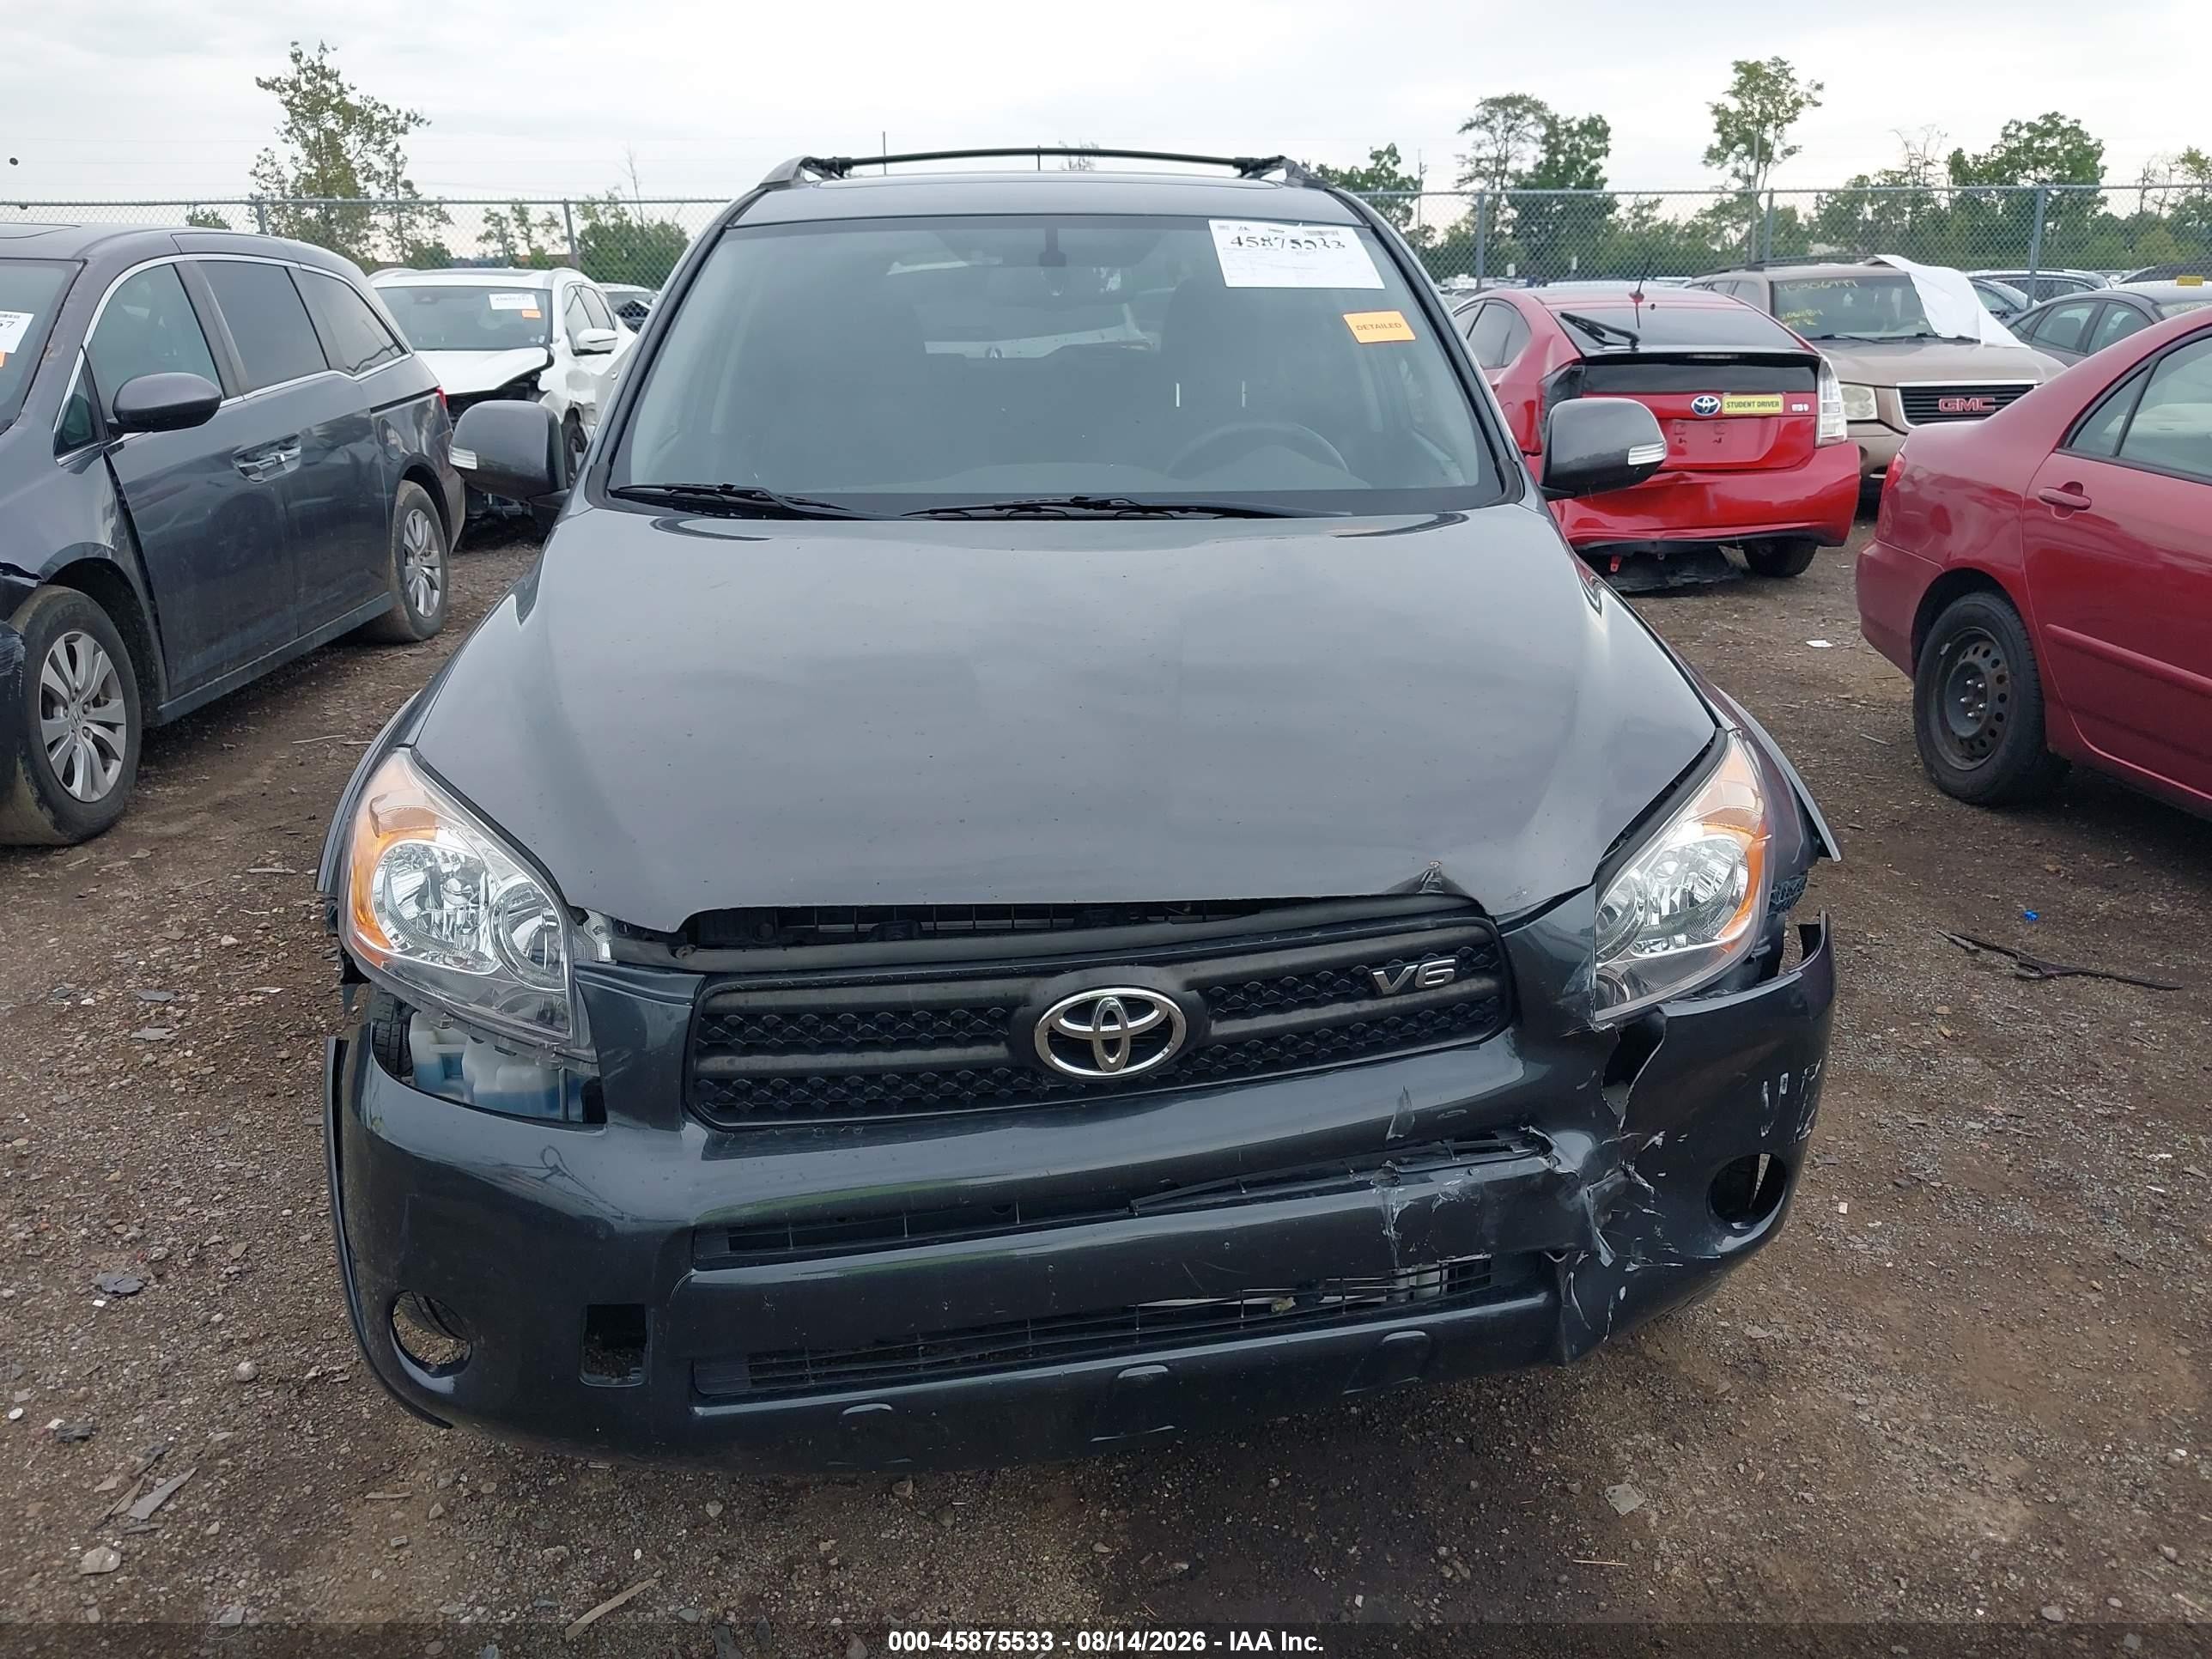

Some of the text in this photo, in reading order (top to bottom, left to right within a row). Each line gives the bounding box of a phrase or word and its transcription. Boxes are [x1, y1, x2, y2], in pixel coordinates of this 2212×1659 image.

[1356, 322, 1402, 331] DETAILED
[1726, 399, 1780, 409] STUDENT DRIVER
[1938, 397, 1996, 412] GMC
[1372, 958, 1456, 995] V6
